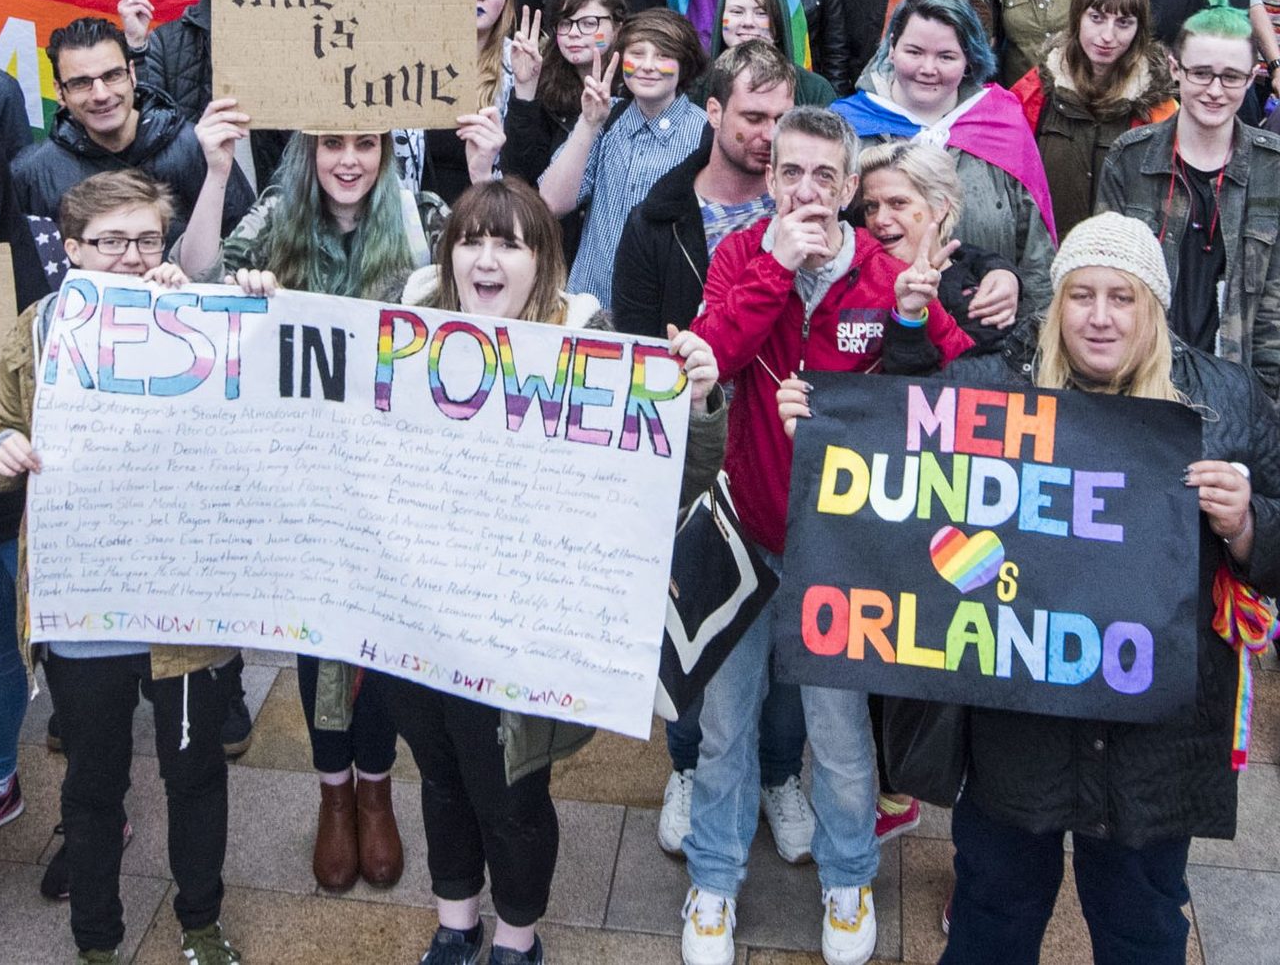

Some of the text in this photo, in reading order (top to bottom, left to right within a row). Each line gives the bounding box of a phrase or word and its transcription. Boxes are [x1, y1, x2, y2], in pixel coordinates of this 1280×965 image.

[313, 14, 359, 59] is
[42, 278, 688, 458] REST IN POWER
[836, 322, 885, 339] SUPER
[837, 338, 869, 354] DRY
[906, 385, 1057, 464] MEH
[817, 445, 1125, 543] DUNDEE
[801, 585, 1154, 695] ORLANDO
